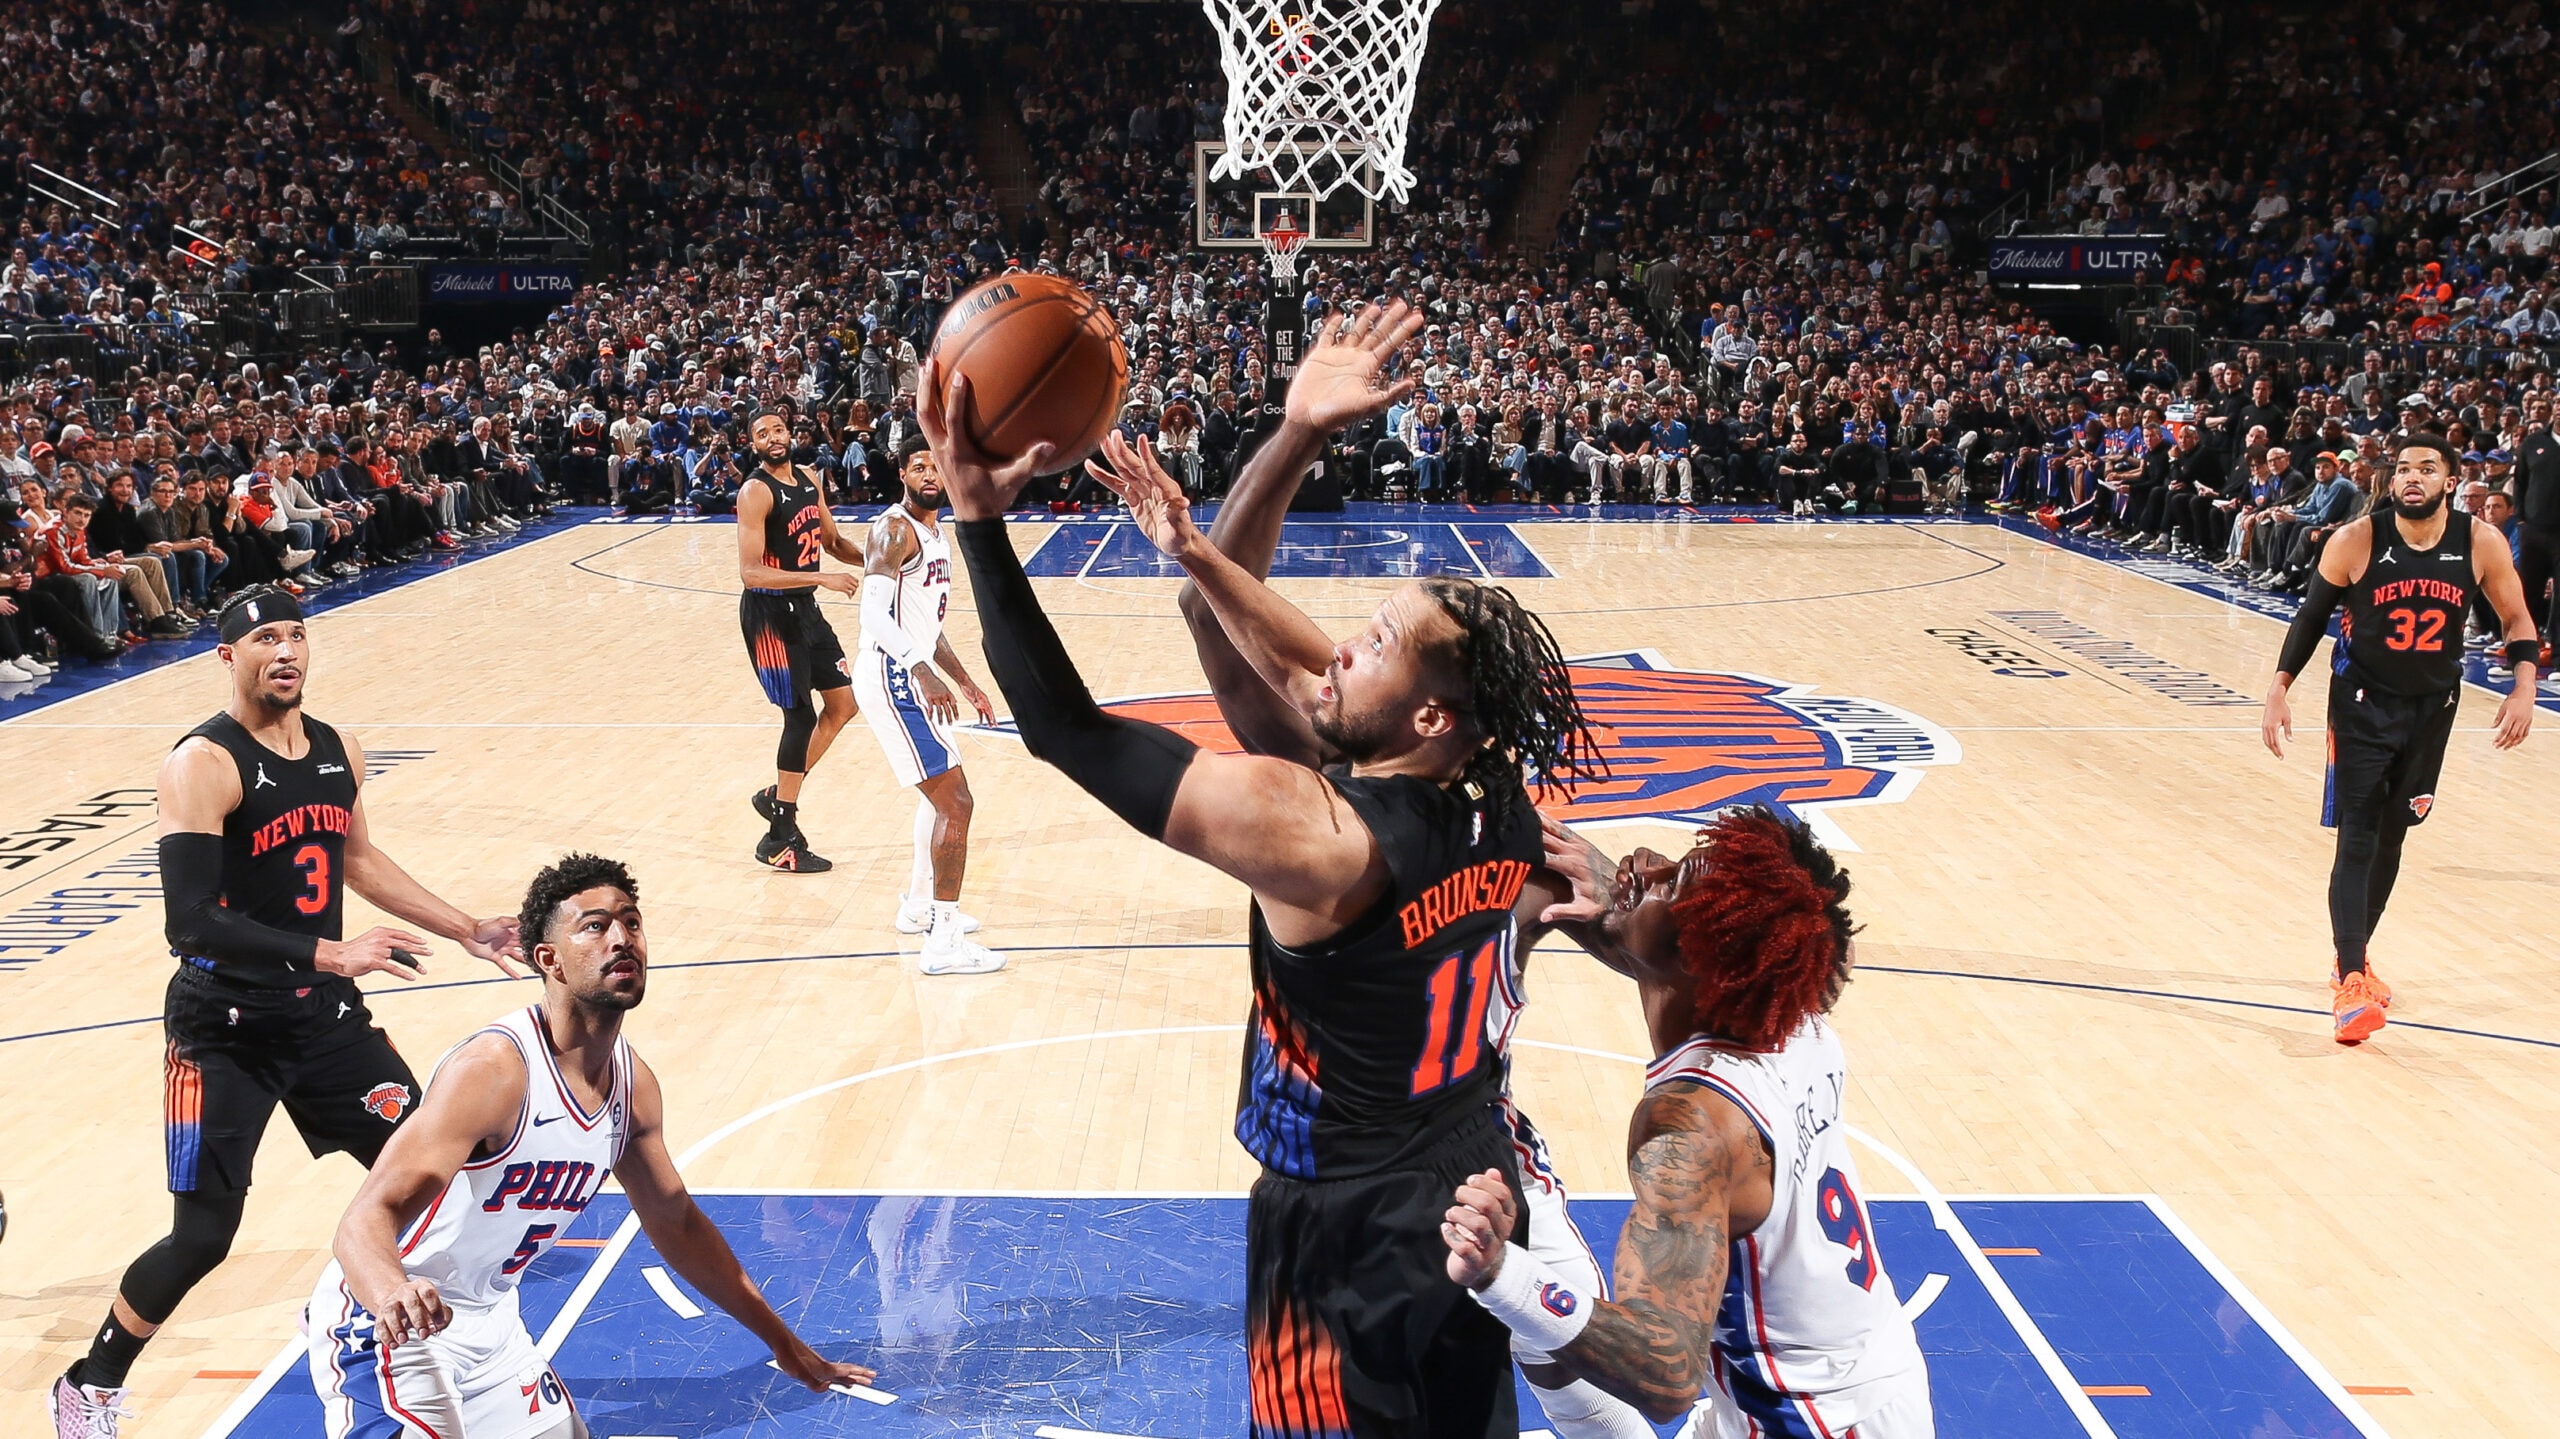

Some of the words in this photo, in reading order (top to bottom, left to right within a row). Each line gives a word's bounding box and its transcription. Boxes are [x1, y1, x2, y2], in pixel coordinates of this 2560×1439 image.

[1989, 248, 2064, 270] Michelob
[2088, 251, 2163, 268] ULTRA
[431, 273, 495, 292] Michelob
[513, 276, 573, 290] ULTRA
[1276, 331, 1293, 345] GET
[1276, 347, 1294, 361] THE
[1280, 362, 1298, 381] App
[797, 526, 821, 568] 25
[937, 592, 948, 622] 8
[2373, 579, 2417, 606] NEW
[2417, 579, 2463, 607] YORK
[1924, 627, 2041, 665] CHASE
[2385, 608, 2447, 651] 32
[1774, 697, 1911, 724] NEW
[1837, 727, 1935, 764] YORK
[252, 806, 306, 857] NEW
[293, 842, 330, 917] 3
[1399, 859, 1532, 950] BRUNSON
[1408, 934, 1498, 1101] 11
[1817, 1165, 1877, 1293] 9
[502, 1223, 557, 1275] 5
[520, 1371, 562, 1416] 76
